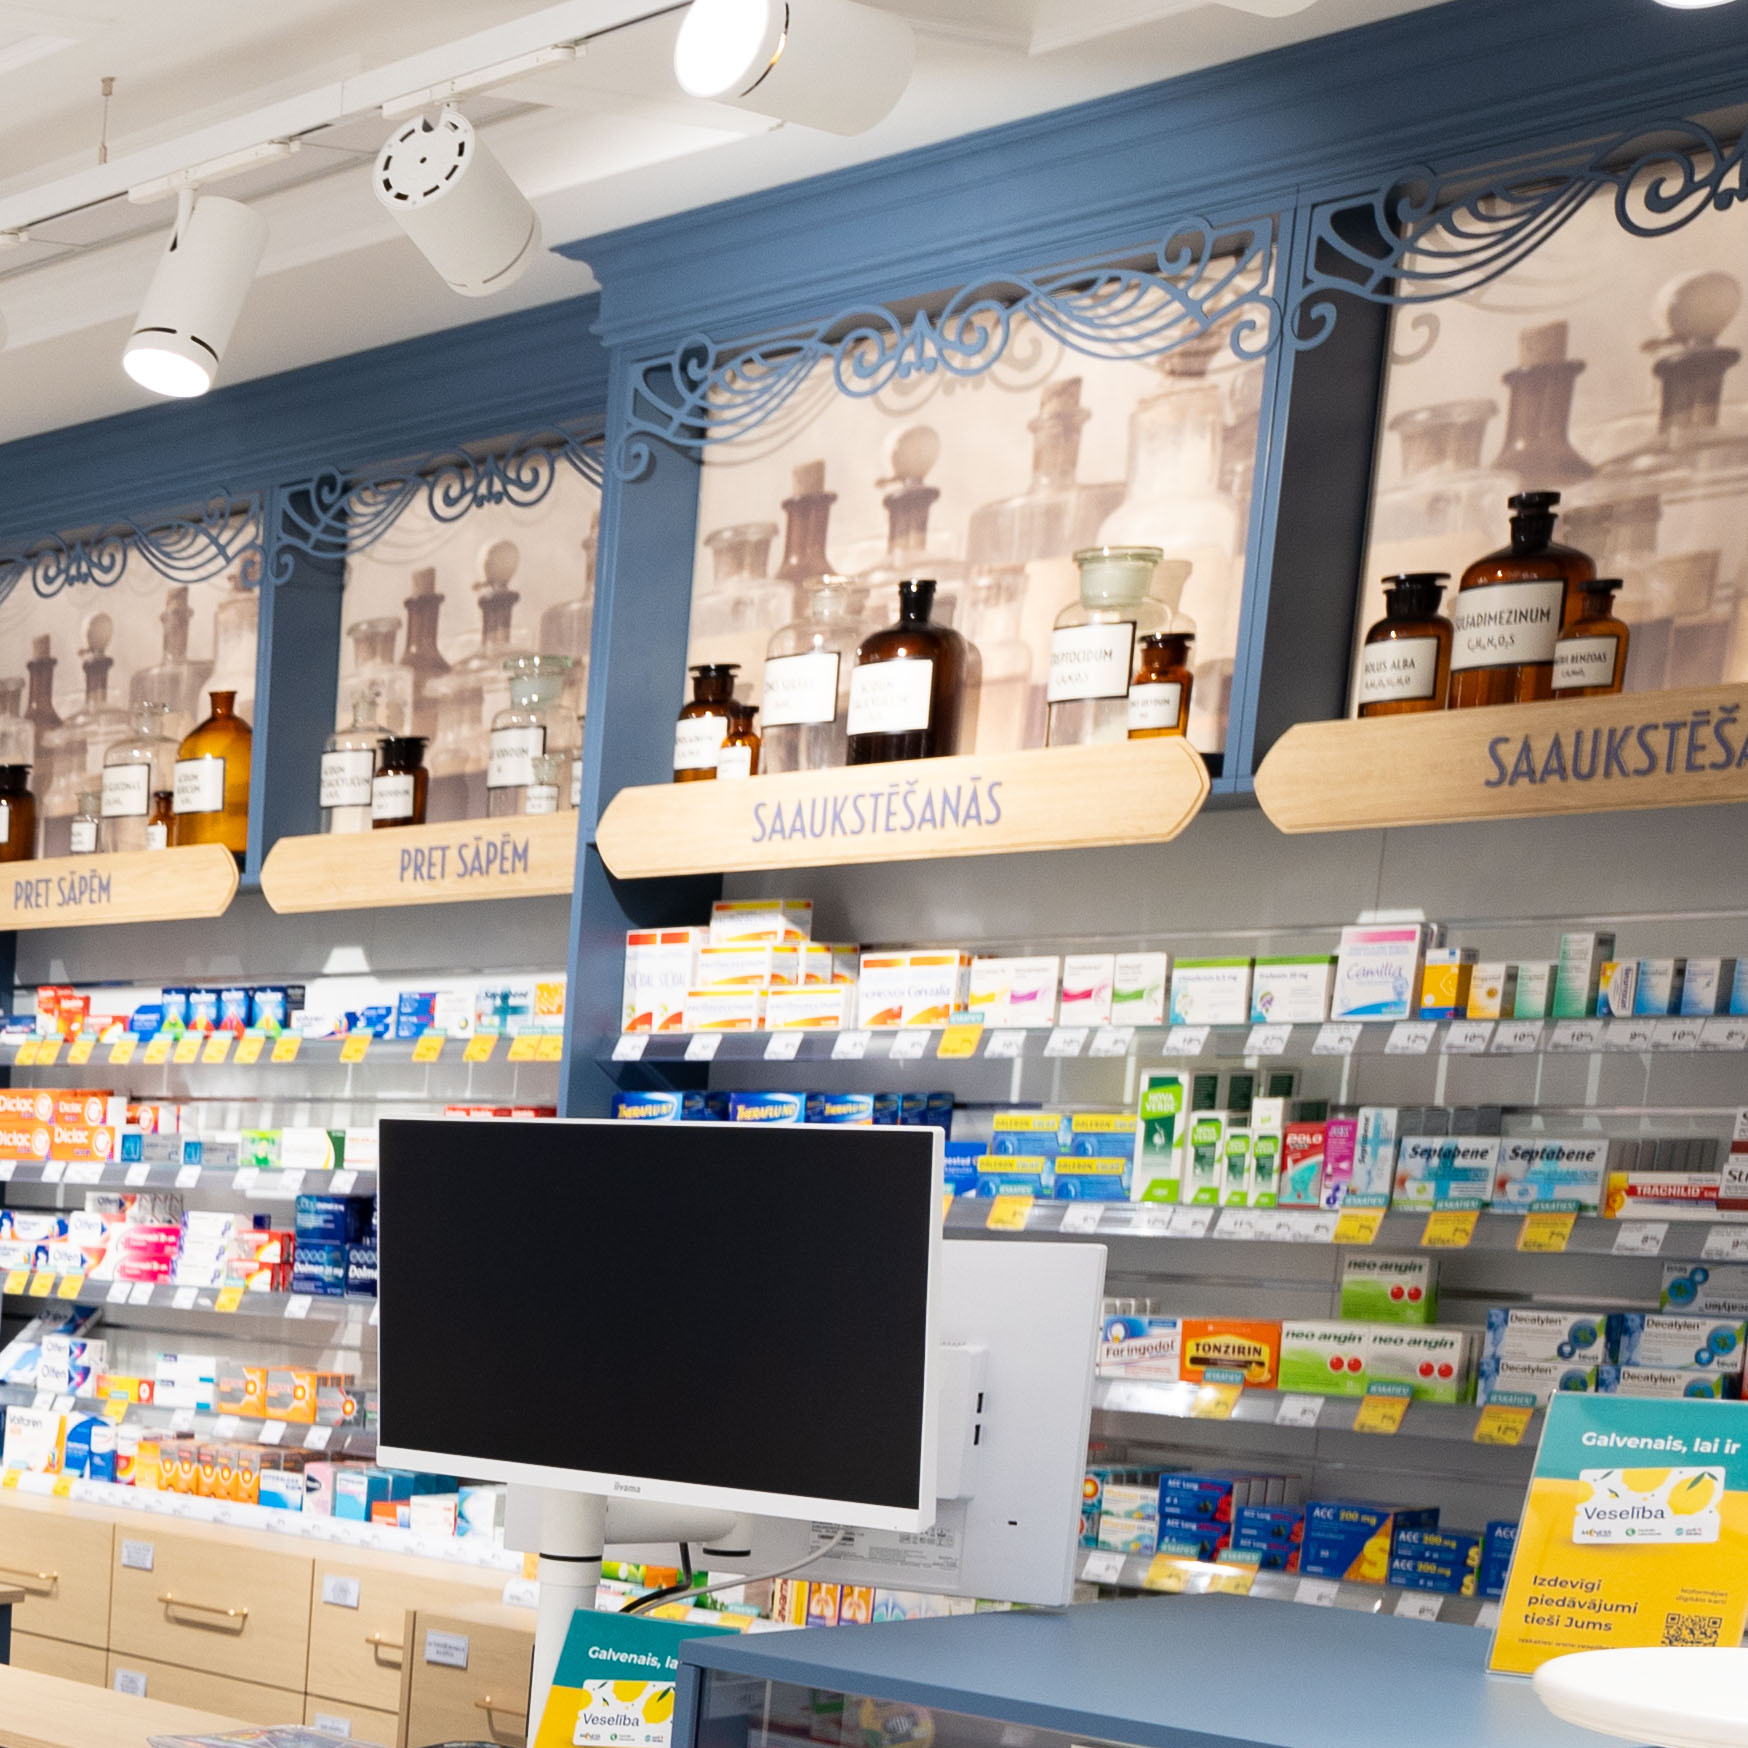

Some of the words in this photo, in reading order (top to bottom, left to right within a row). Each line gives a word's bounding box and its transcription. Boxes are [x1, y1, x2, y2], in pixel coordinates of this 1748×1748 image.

[751, 775, 1003, 844] SAAUKSTĒŠANĀS
[400, 845, 450, 882] PRET
[457, 835, 530, 879] SĀPĒM
[13, 878, 50, 911] PRET
[57, 869, 111, 907] SĀPĒM
[1145, 1101, 1176, 1112] VERDE
[54, 1127, 89, 1146] Diclac
[1408, 1145, 1490, 1162] Septabene
[1509, 1145, 1596, 1163] Septabene
[1636, 1185, 1700, 1199] TRACHILID
[1509, 1313, 1562, 1326] Decatylen
[1645, 1318, 1700, 1331] Decatylen
[1194, 1342, 1263, 1358] TONZIRIN
[1500, 1362, 1552, 1375] Decatylen
[1622, 1370, 1675, 1384] Decatylen
[1581, 1432, 1688, 1454] Galvenais,
[1693, 1438, 1720, 1454] lai
[1724, 1439, 1741, 1455] ir
[1314, 1507, 1334, 1519] ACC
[1360, 1513, 1377, 1527] mg
[1584, 1506, 1665, 1521] Veselība
[1398, 1530, 1419, 1543] ACC
[1392, 1559, 1414, 1571] ACC
[1533, 1575, 1602, 1592] Izdevīgi
[1528, 1594, 1639, 1614] piedāvājumi
[1523, 1613, 1559, 1627] tieši
[1564, 1616, 1613, 1632] Jums
[588, 1646, 661, 1669] Galvenais,
[665, 1658, 680, 1669] la
[583, 1713, 640, 1728] Veselība
